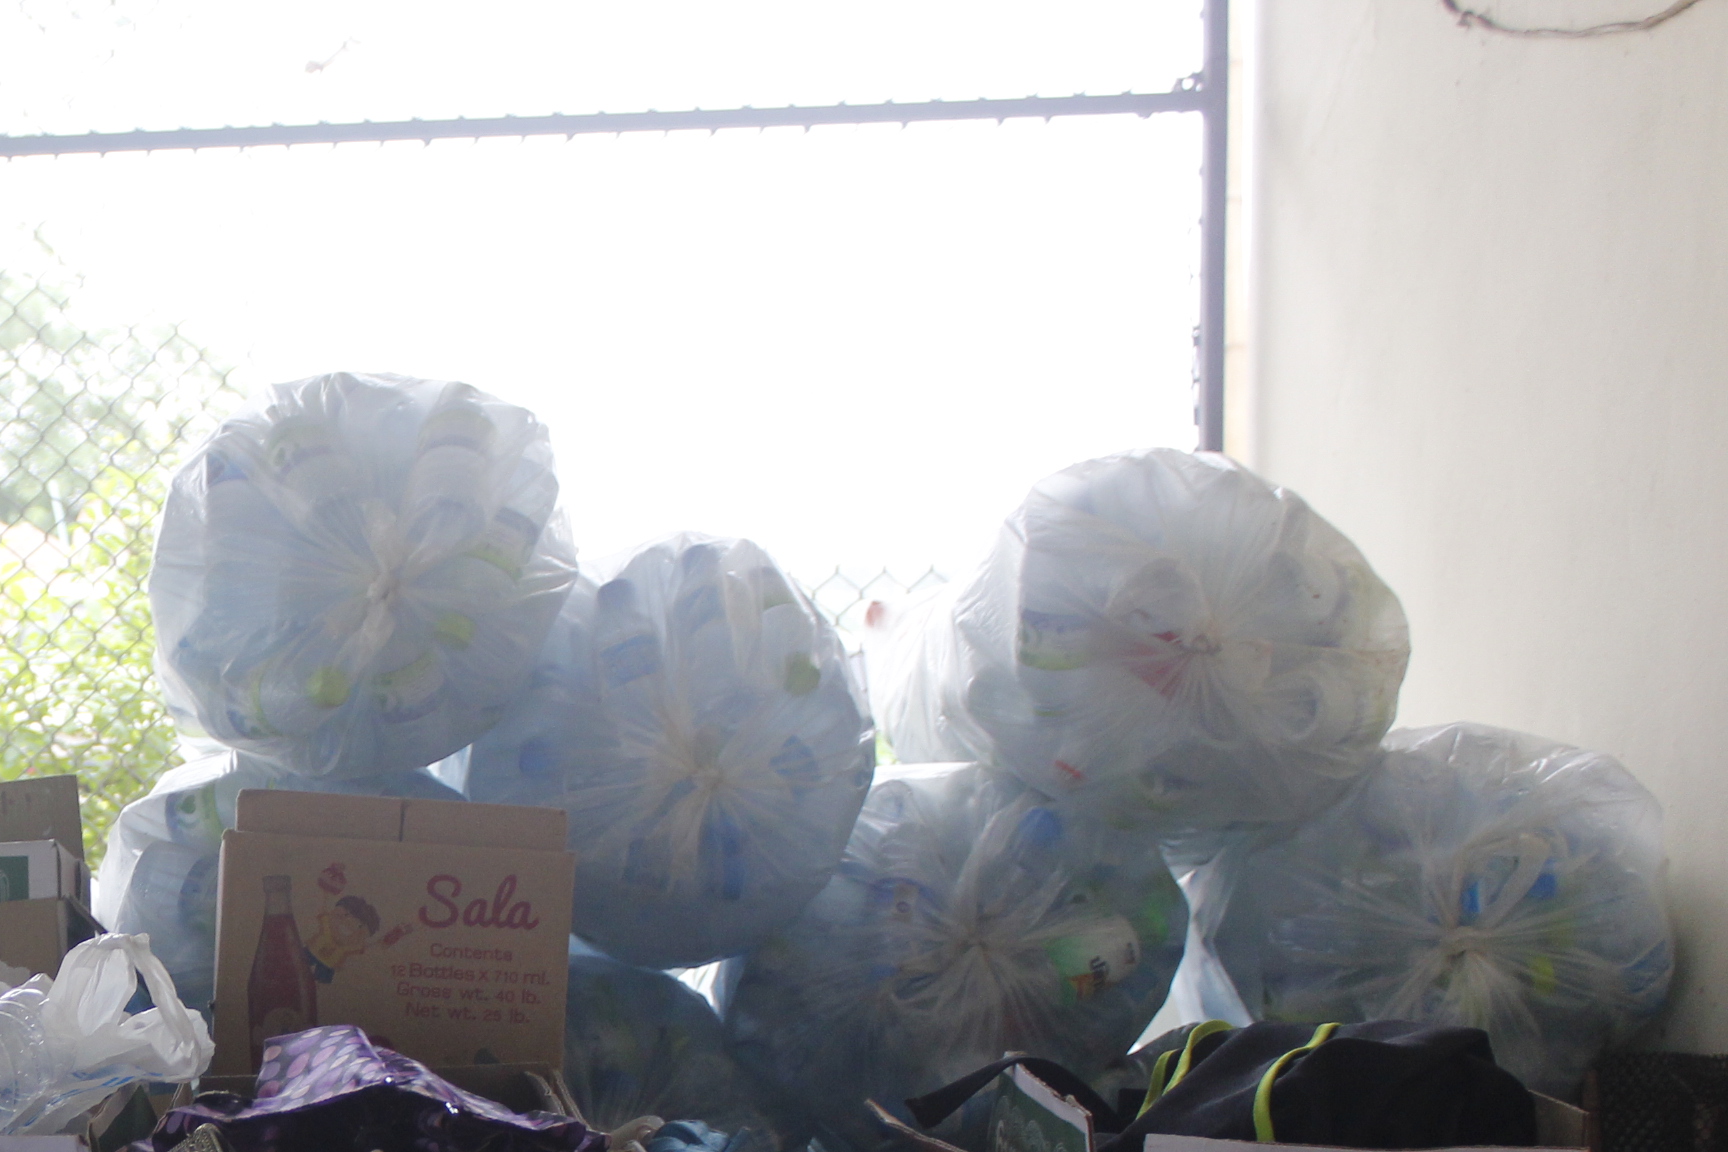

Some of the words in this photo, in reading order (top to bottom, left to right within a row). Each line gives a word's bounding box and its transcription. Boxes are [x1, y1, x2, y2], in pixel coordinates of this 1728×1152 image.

[418, 874, 540, 929] Sala
[430, 943, 513, 961] Contents
[391, 965, 406, 977] 12
[409, 963, 475, 980] Bottles
[495, 969, 519, 983] 710
[397, 982, 452, 999] Gross
[460, 988, 489, 1002] wt.
[495, 990, 515, 1002] 40
[521, 989, 541, 1004] lb.
[405, 1002, 440, 1018] Net
[447, 1007, 477, 1021] wt.
[483, 1009, 502, 1022] 25
[509, 1009, 531, 1024] lb.
